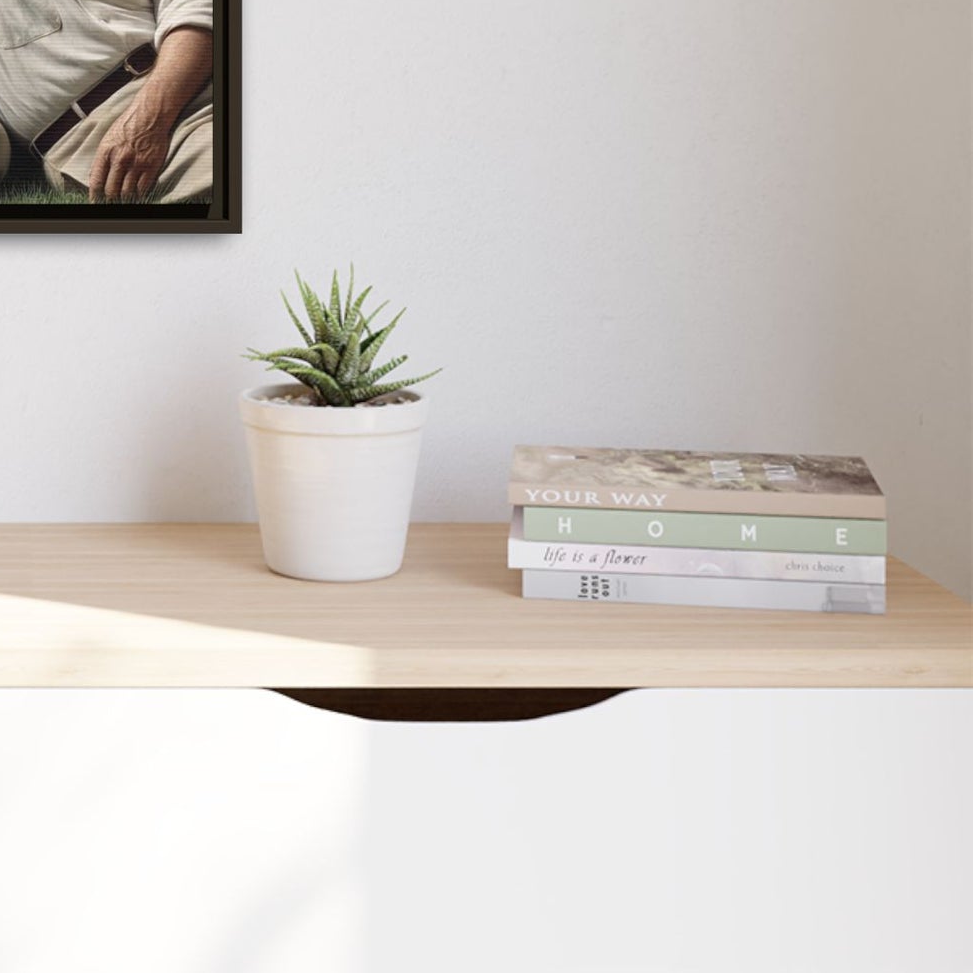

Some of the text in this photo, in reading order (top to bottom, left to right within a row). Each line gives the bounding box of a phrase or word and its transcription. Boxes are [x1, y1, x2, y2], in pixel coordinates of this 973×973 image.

[526, 489, 667, 506] YOUR WAY
[543, 546, 647, 568] life is a flower
[785, 560, 845, 573] chris choice
[578, 575, 588, 598] love
[591, 575, 599, 600] runs
[601, 578, 610, 597] out
